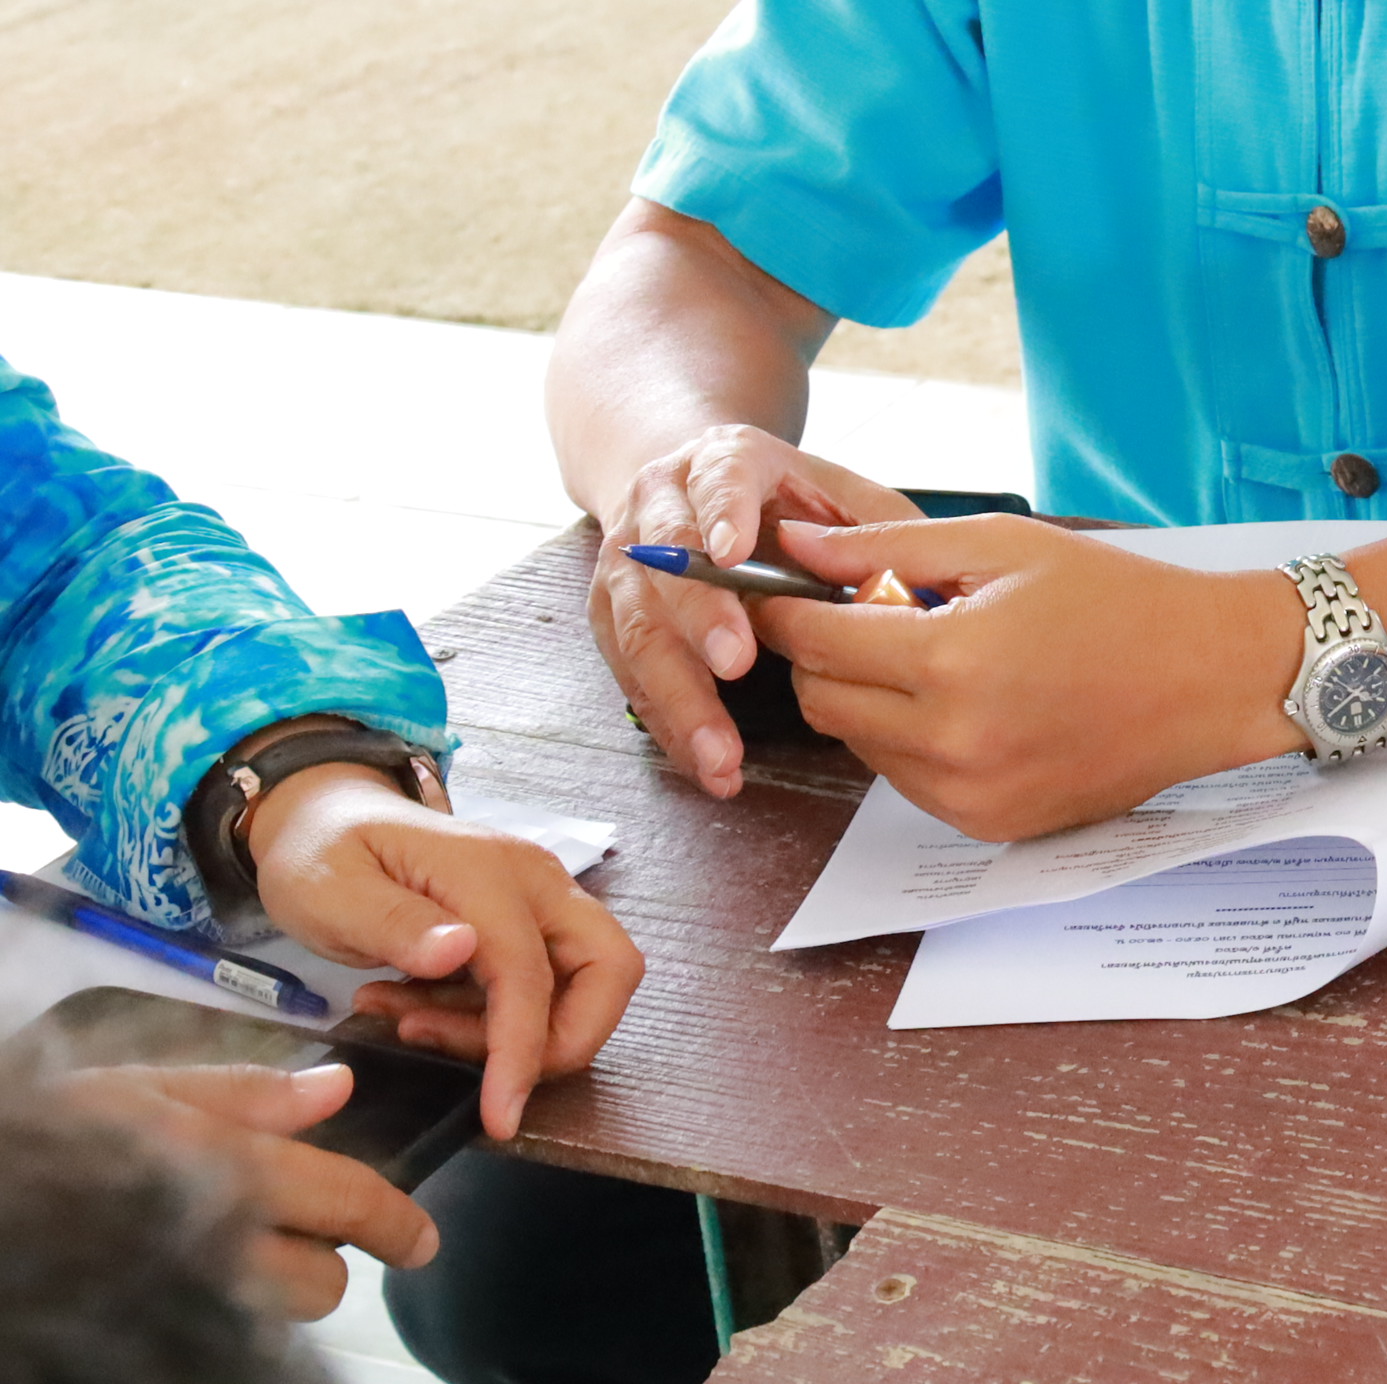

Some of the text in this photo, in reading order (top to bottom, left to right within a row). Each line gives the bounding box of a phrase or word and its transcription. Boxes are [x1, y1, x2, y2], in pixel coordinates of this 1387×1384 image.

[1063, 923, 1126, 933] จังหวัดยะลา
[1207, 920, 1269, 928] ตำบลสะเอะ
[1276, 930, 1331, 941] พฤษภาคม
[1262, 945, 1292, 954] ครั้งที่
[1186, 965, 1306, 979] ระเบียบวาระการประชุม
